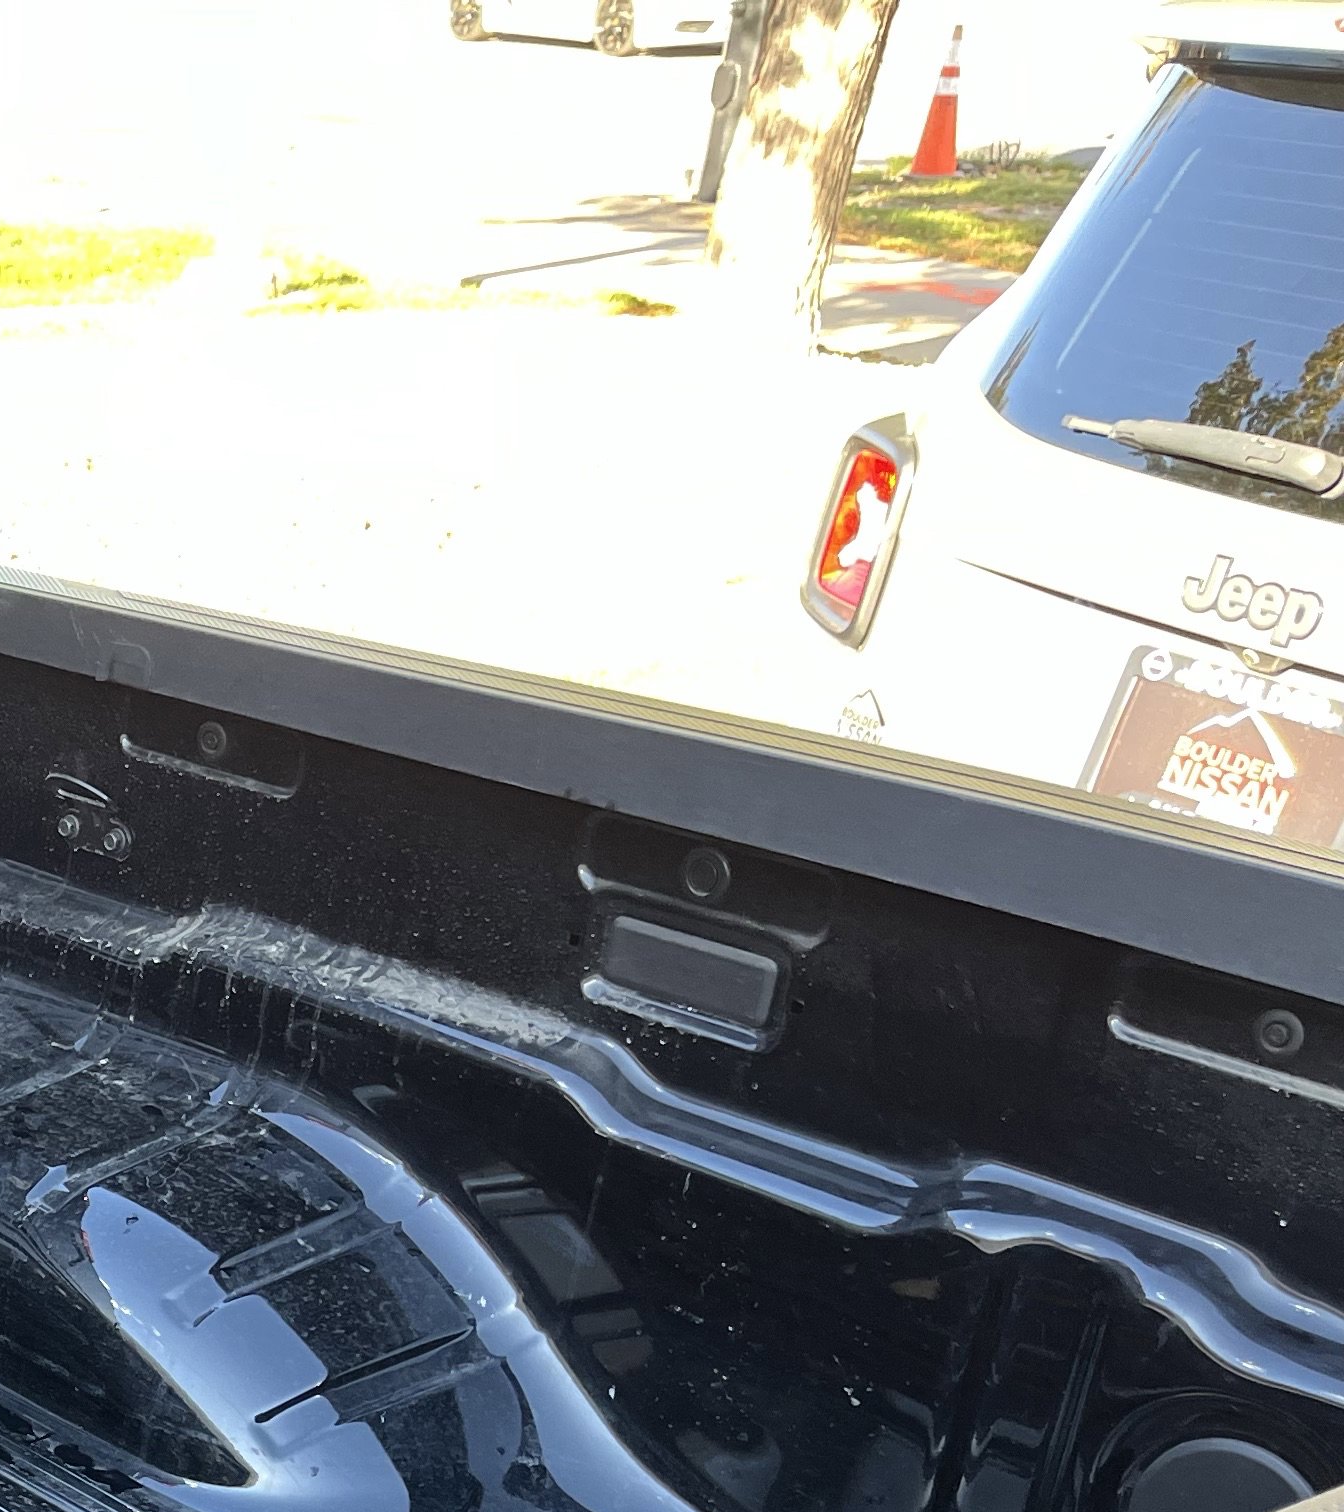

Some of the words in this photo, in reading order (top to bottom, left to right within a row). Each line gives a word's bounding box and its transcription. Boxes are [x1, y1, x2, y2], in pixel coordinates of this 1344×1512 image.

[1182, 554, 1324, 648] Jeep
[1162, 755, 1290, 822] NISSAN
[1173, 735, 1279, 785] BOULDER
